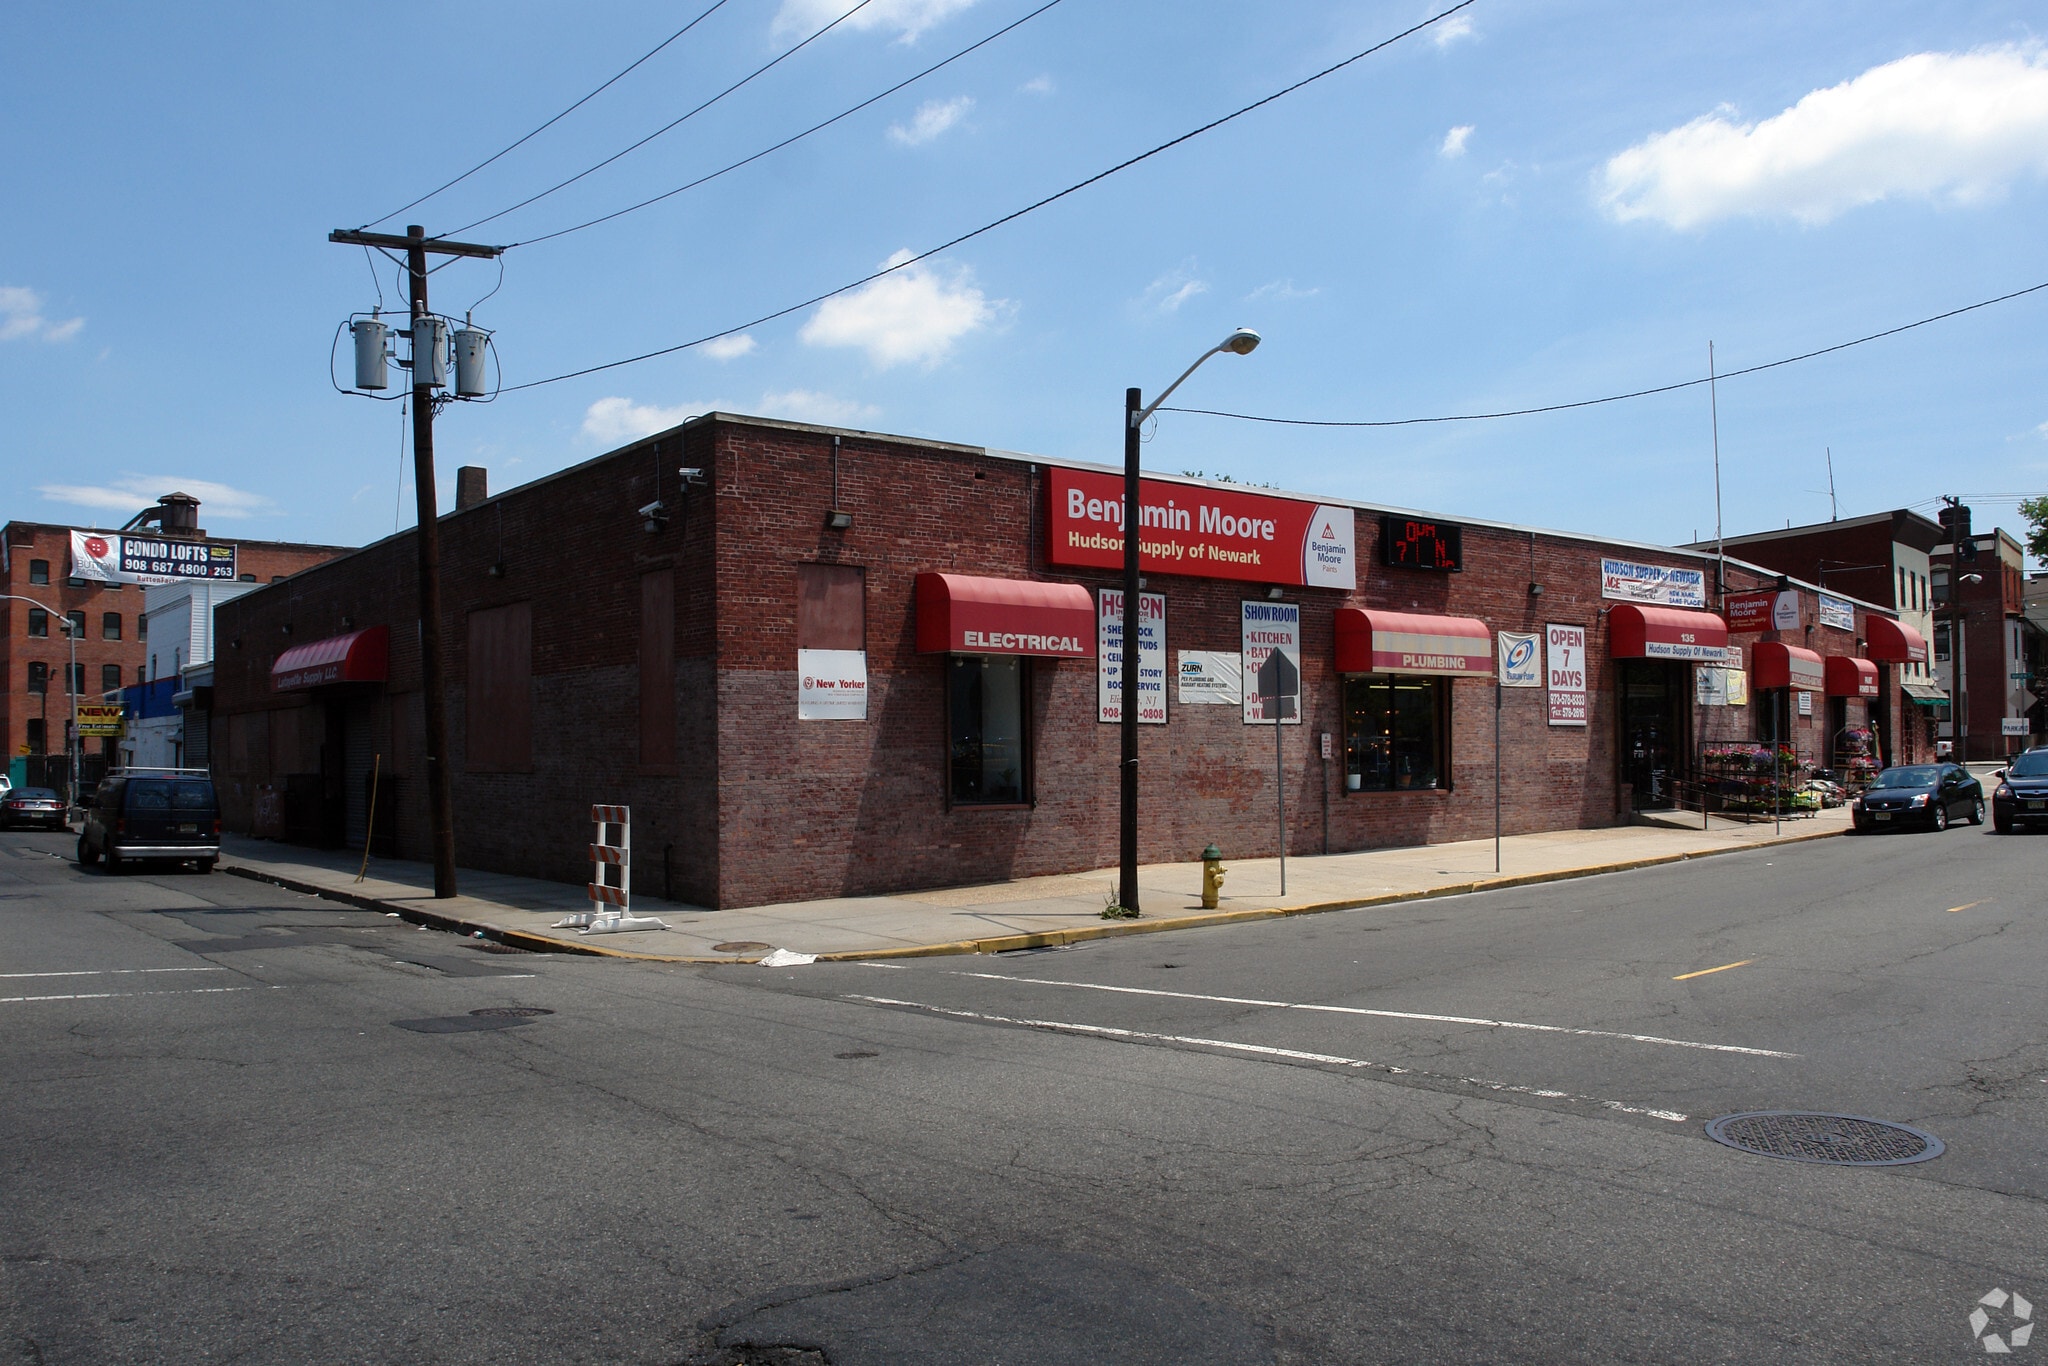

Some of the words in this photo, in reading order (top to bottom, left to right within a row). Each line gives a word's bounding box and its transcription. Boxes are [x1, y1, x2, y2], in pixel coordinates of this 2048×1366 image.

[1067, 488, 1190, 532] Benjmin
[1199, 505, 1275, 541] Moore
[125, 540, 168, 559] CONDO
[171, 544, 208, 562] LOFTS
[1188, 545, 1205, 559] of
[1208, 545, 1261, 565] Newark
[1311, 541, 1347, 555] Benjamin
[1317, 552, 1342, 564] Moore
[77, 559, 116, 572] BUTTON
[125, 559, 147, 571] 908
[152, 561, 173, 573] 687
[178, 563, 208, 576] 4800
[213, 566, 233, 577] 263
[1322, 564, 1338, 574] Paints
[1604, 560, 1634, 577] HUDSON
[1635, 565, 1662, 581] SUPPLY
[1670, 570, 1700, 585] NEWARK
[1604, 576, 1621, 589] ACE
[1102, 593, 1162, 620] HUON
[1729, 599, 1768, 610] Benjamin
[1245, 604, 1298, 622] SHOWROOM
[1730, 608, 1757, 617] Moore
[964, 630, 1084, 652] ELECTRICAL
[1250, 631, 1293, 645] KITCHEN
[1550, 629, 1583, 648] OPEN
[1680, 633, 1696, 643] 135
[1563, 649, 1571, 667] 7
[1649, 644, 1671, 655] Hudson
[1672, 645, 1692, 657] Supply
[1701, 647, 1723, 658] Newark
[1181, 664, 1203, 673] ZURN
[1402, 654, 1466, 669] PLUMBING
[303, 669, 323, 685] Supply
[324, 666, 338, 680] LLC
[1107, 667, 1118, 676] UP
[1140, 668, 1163, 678] STORY
[1551, 670, 1583, 688] DAYS
[816, 679, 836, 689] New
[838, 679, 866, 689] Yorker
[78, 707, 120, 717] NEW
